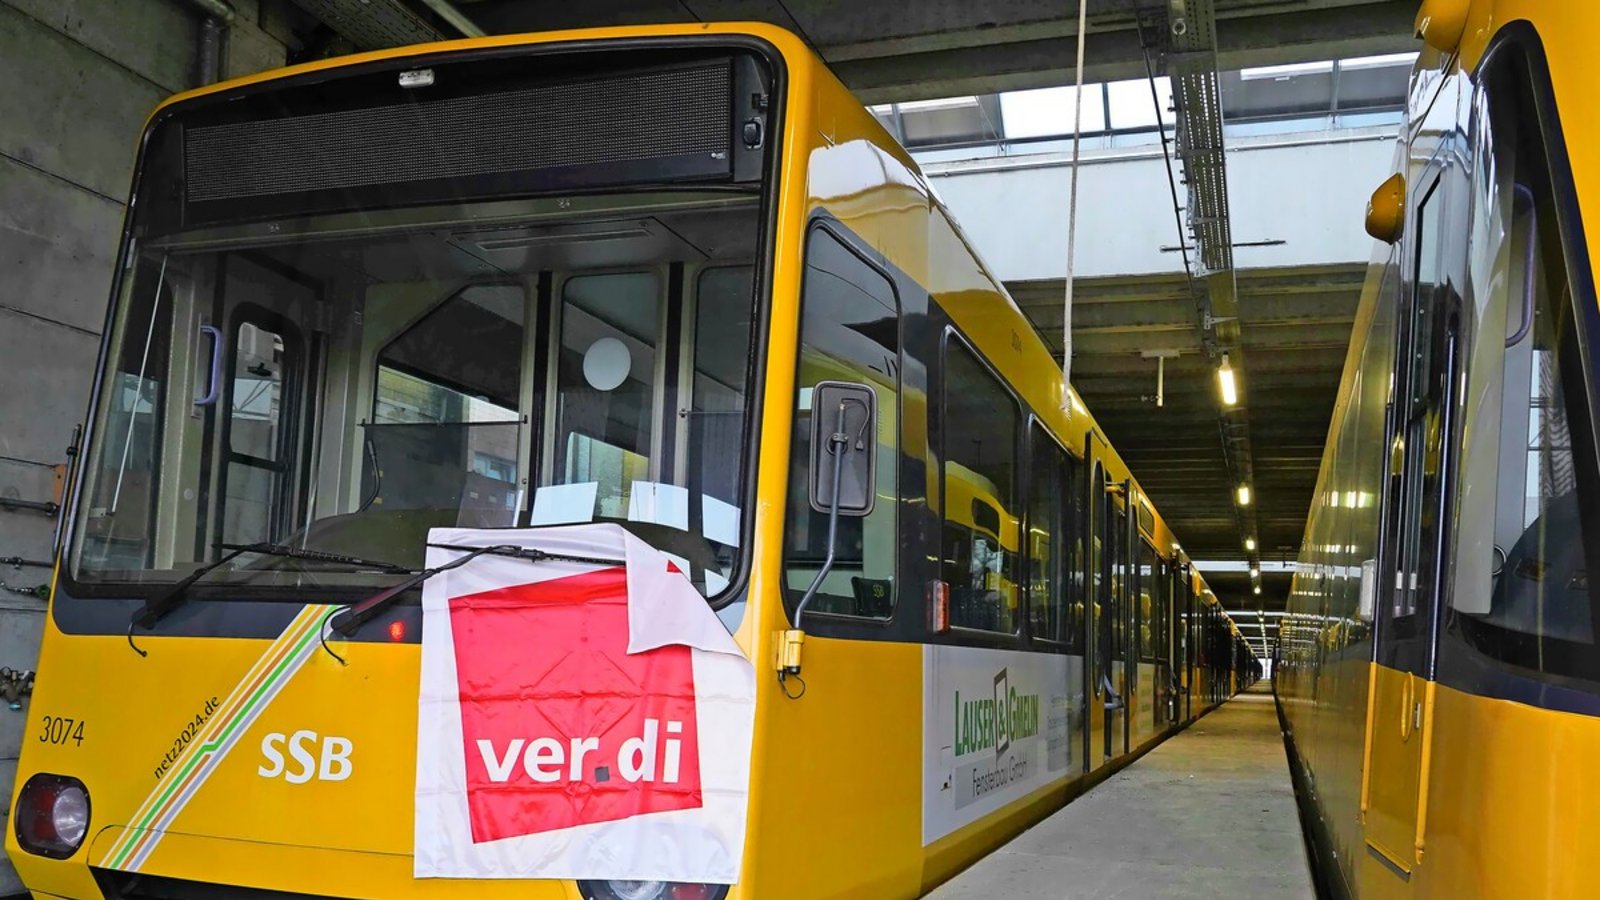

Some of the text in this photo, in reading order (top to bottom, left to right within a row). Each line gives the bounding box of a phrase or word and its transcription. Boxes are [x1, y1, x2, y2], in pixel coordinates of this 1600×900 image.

[39, 715, 85, 747] 3074
[153, 696, 220, 780] netz2024.de
[258, 730, 354, 784] SSB
[972, 768, 1008, 797] Fensterbau
